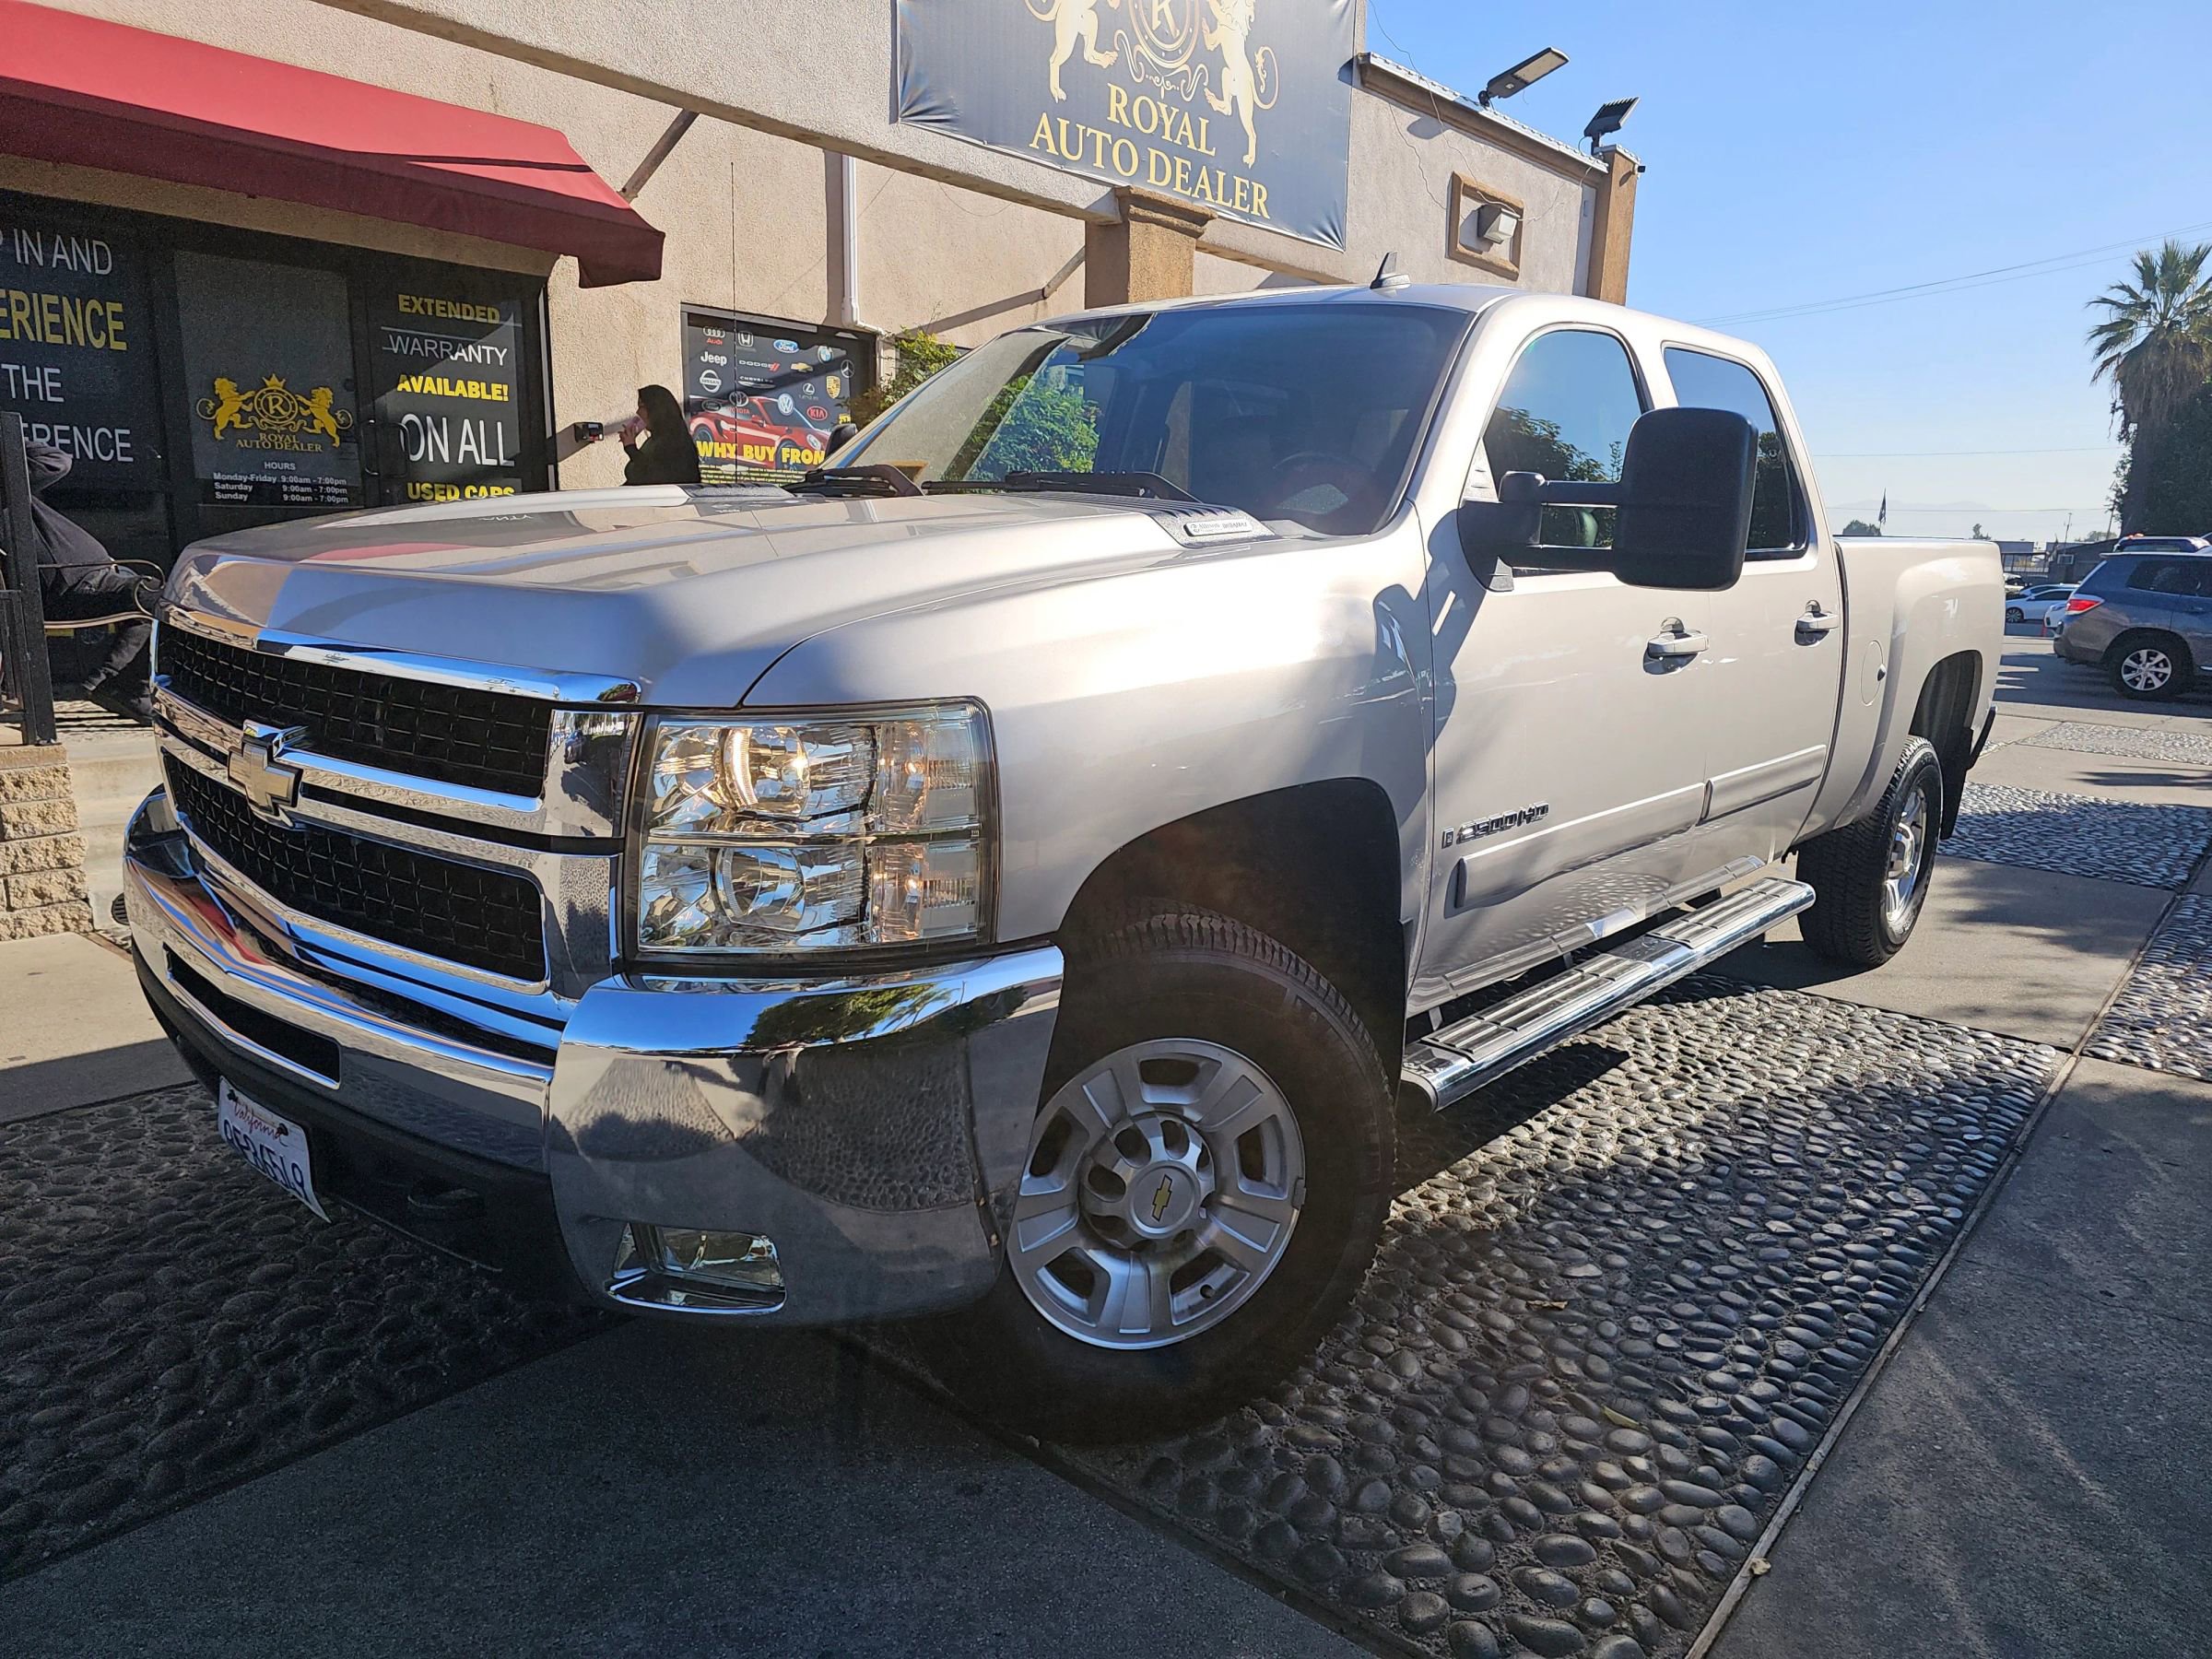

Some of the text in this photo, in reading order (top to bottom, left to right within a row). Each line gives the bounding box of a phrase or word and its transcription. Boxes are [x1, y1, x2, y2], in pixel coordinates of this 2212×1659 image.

[1107, 83, 1217, 157] ROYAL
[1029, 112, 1270, 220] AUTO DEALER
[14, 228, 44, 266] IN
[52, 234, 112, 275] AND
[398, 294, 500, 324] EXTENDED
[389, 334, 508, 366] WARRANTY
[700, 351, 728, 367] Jeep
[1, 363, 65, 403] THE
[396, 374, 510, 402] AVAILABLE!
[266, 394, 288, 416] R
[810, 408, 826, 418] KIA
[22, 422, 134, 462] RENCE
[236, 439, 324, 452] AUTO DEALER
[259, 432, 300, 442] ROYAL
[400, 413, 515, 467] ON ALL
[696, 441, 737, 459] WHY
[743, 444, 776, 462] BUY
[264, 462, 296, 471] HOURS
[213, 472, 276, 484] Monday-Friday
[281, 476, 311, 484] 9:00am
[317, 477, 347, 485] 7:00pm
[214, 482, 253, 492] Saturday
[282, 485, 312, 493] 9:00am
[318, 486, 347, 495] 7:00pm
[215, 491, 248, 501] Sunday
[320, 495, 348, 503] 7:00pm
[407, 482, 460, 502] USED
